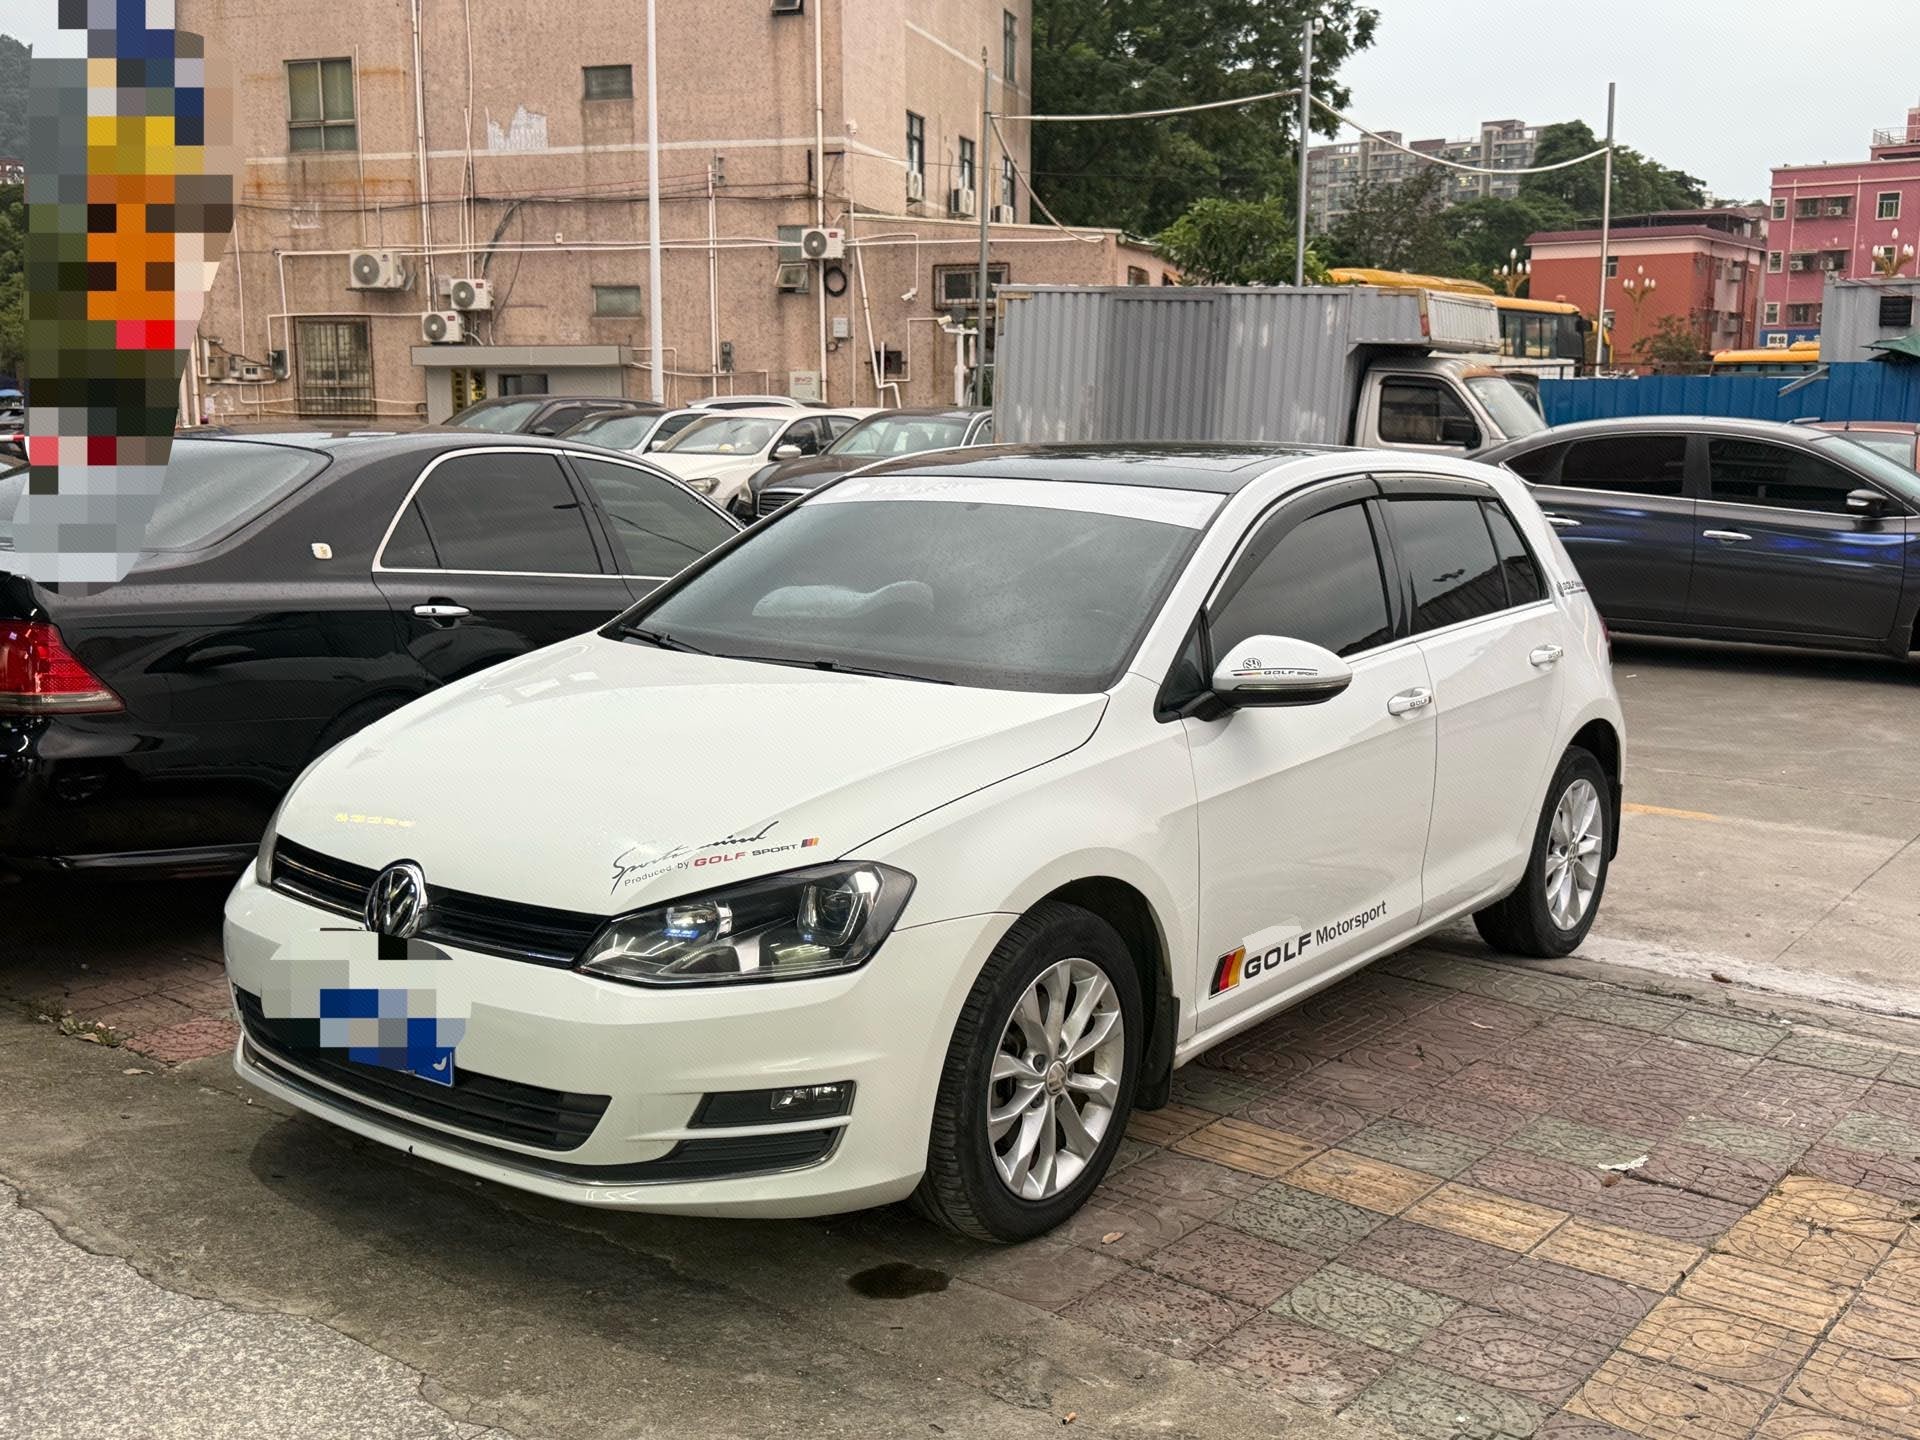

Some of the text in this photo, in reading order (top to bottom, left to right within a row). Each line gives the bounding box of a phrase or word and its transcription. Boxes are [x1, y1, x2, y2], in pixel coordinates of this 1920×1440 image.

[624, 843, 798, 887] Produced by GOLF SPORT
[1243, 899, 1388, 980] GOLF Motorsport
